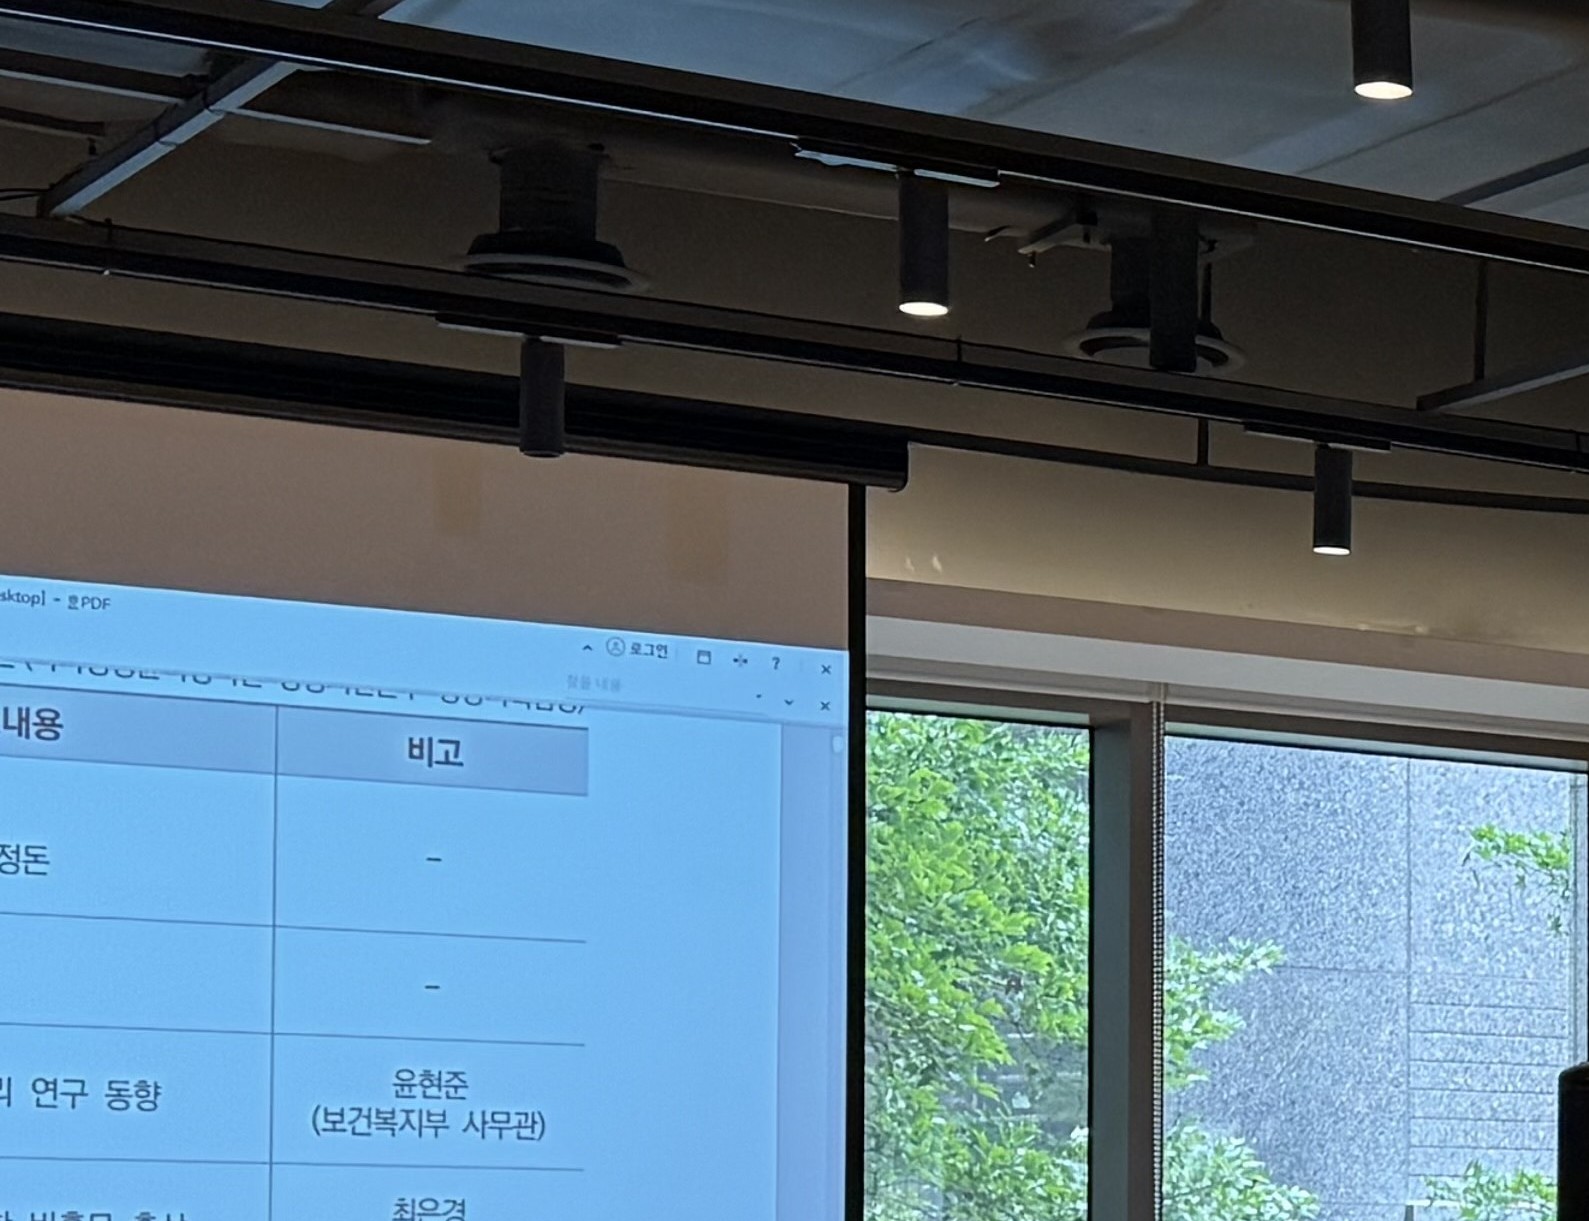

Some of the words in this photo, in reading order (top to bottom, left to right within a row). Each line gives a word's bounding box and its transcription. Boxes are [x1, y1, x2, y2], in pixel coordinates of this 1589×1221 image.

[630, 641, 669, 659] 로그인
[3, 705, 64, 742] 내용
[407, 734, 465, 769] 비고
[0, 843, 50, 876] 정돈
[31, 1076, 89, 1110] 연구
[104, 1079, 162, 1112] 동향
[392, 1068, 469, 1100] 윤현준
[311, 1104, 450, 1139] (보건복지부
[461, 1109, 546, 1142] 사무관)
